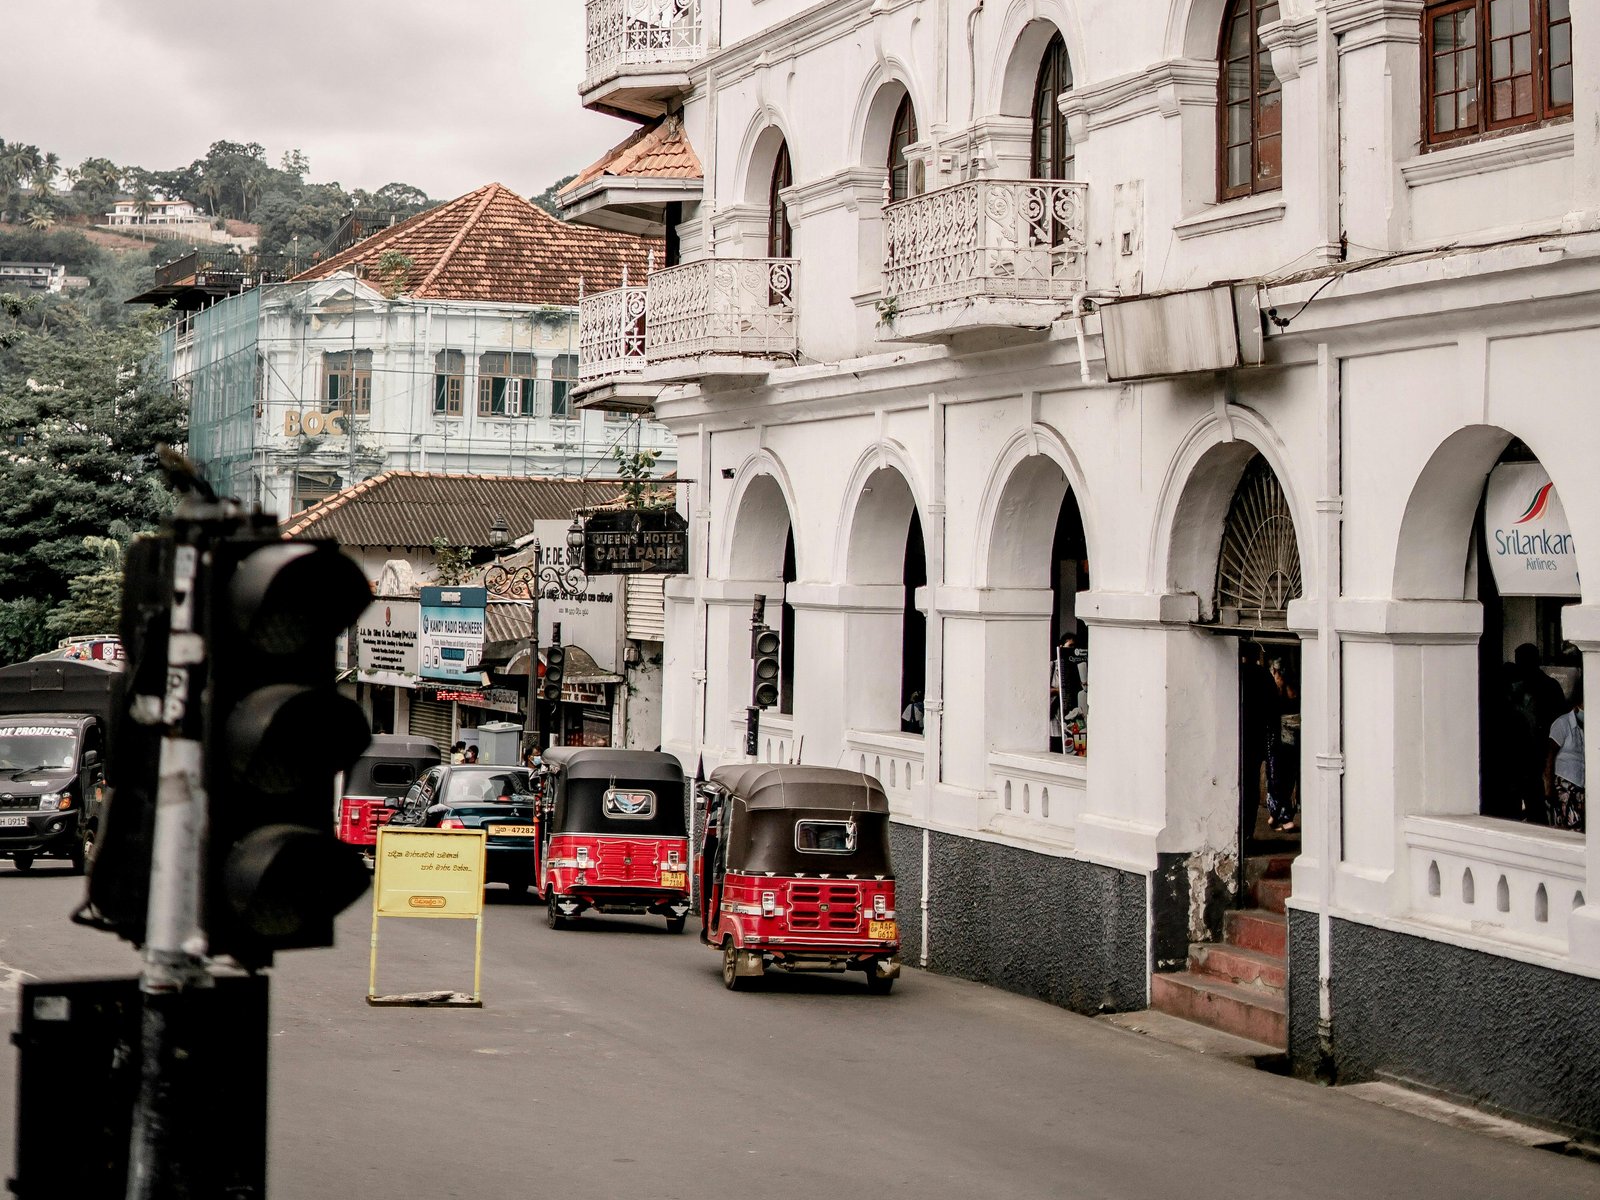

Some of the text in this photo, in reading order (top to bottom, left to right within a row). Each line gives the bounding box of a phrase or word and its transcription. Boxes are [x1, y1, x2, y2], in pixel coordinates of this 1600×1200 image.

[284, 410, 344, 437] BOC
[643, 533, 681, 544] HOTEL
[1495, 529, 1576, 556] SriLankan
[594, 546, 680, 561] CAR PARK
[1526, 557, 1557, 571] Airlines
[430, 620, 482, 634] KANDY RADIO ENGINEERS
[15, 727, 75, 736] PRODUCTS
[8, 817, 26, 825] 0915
